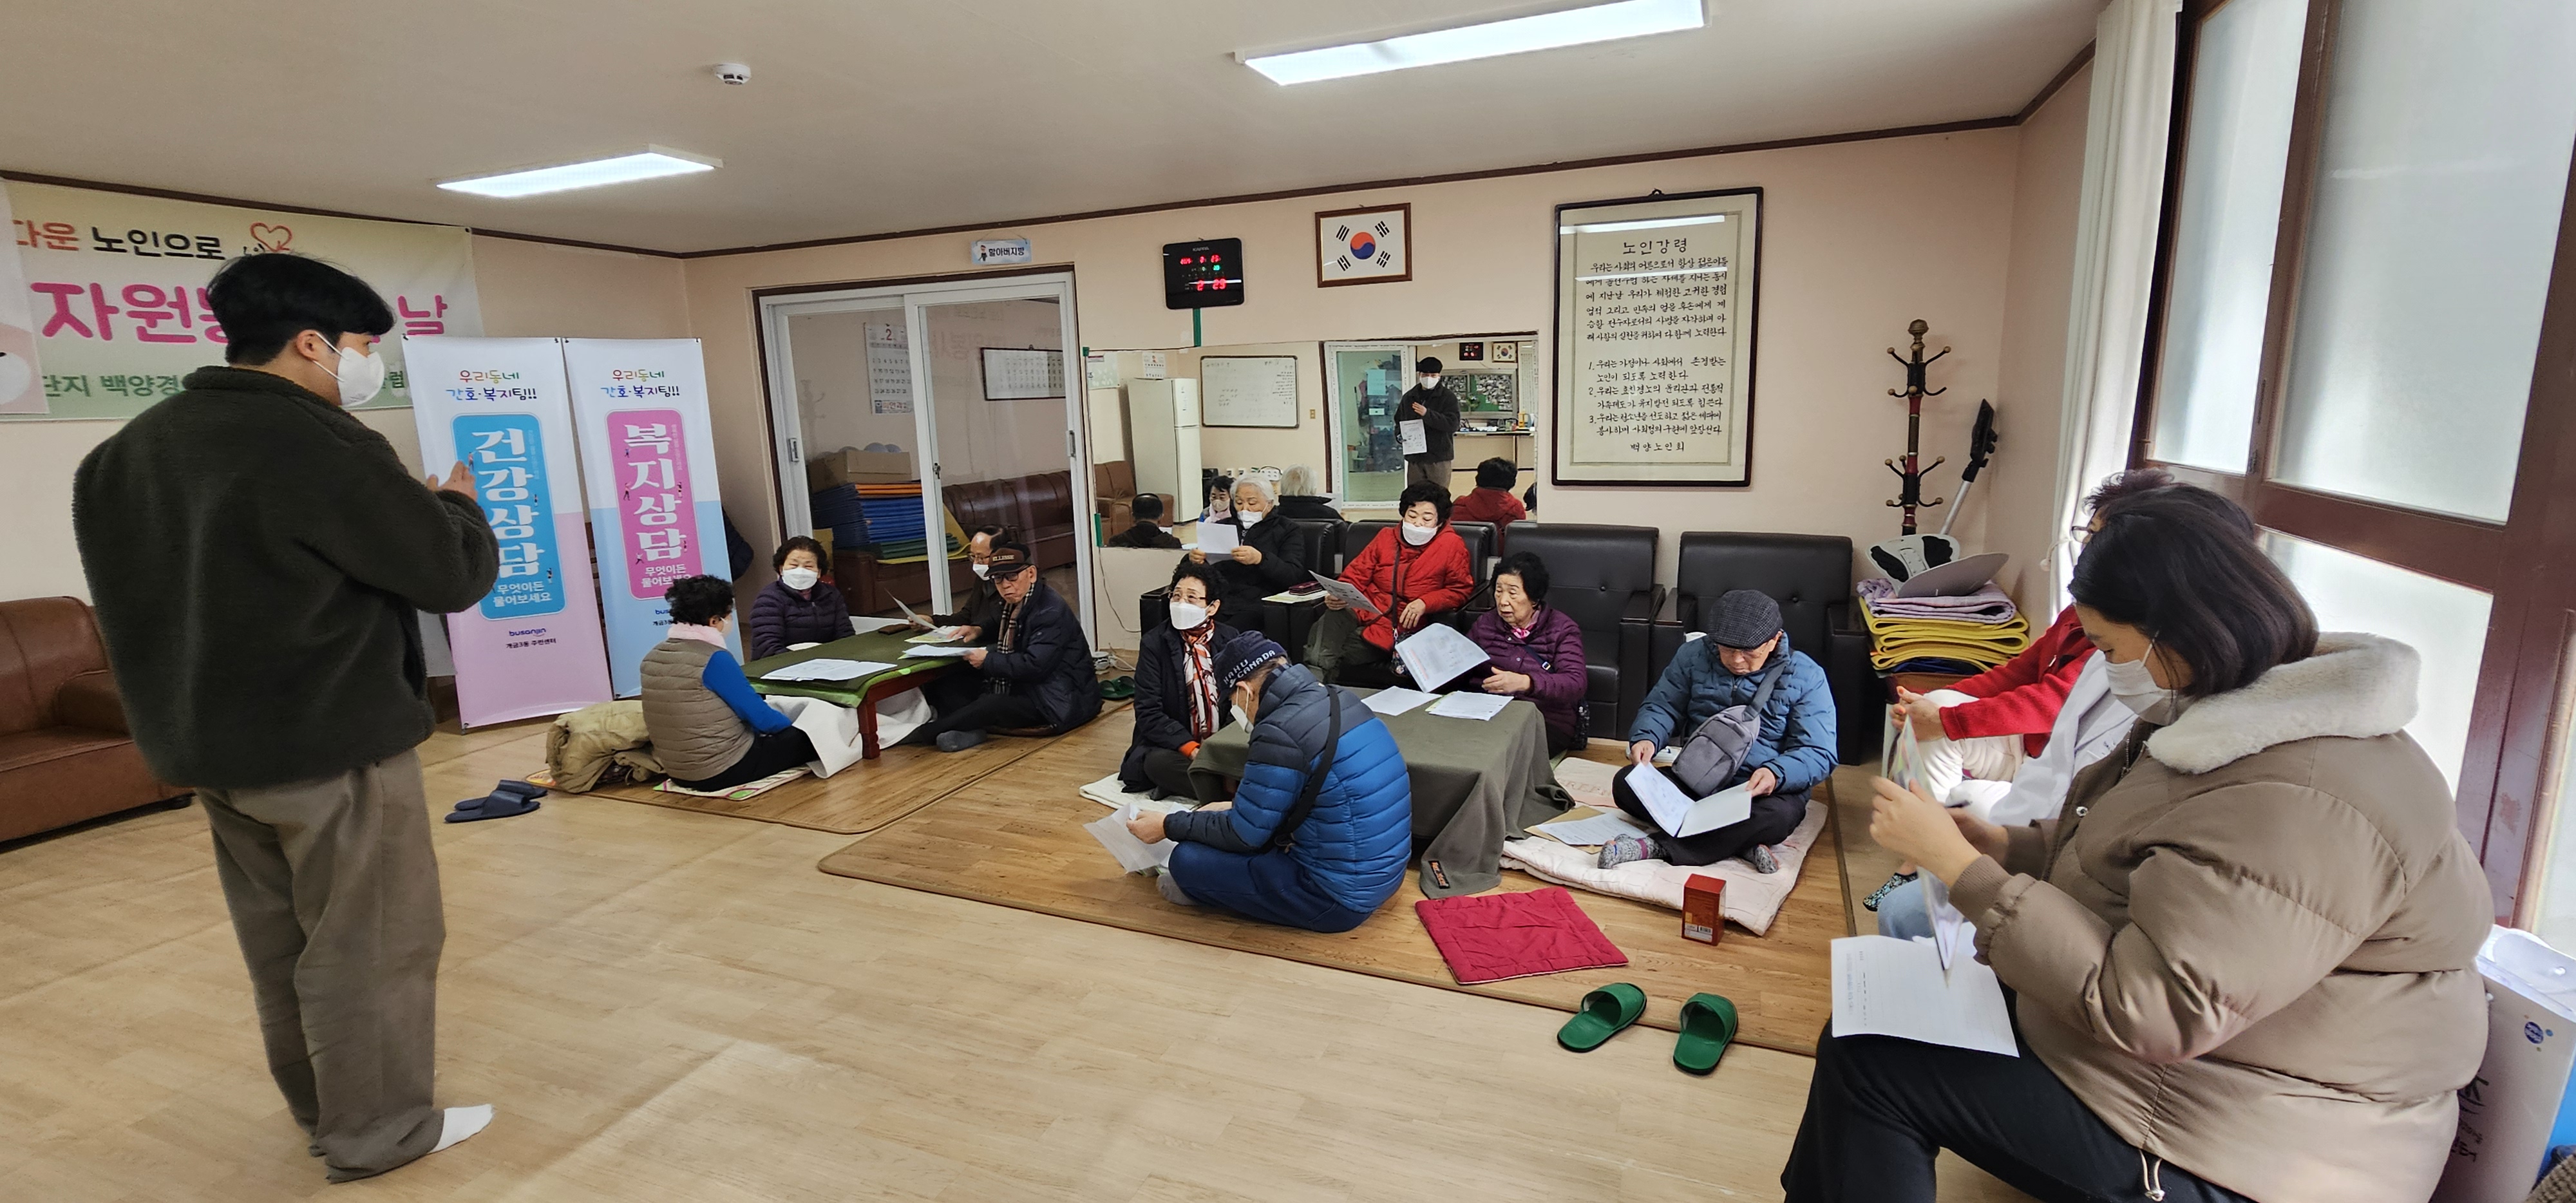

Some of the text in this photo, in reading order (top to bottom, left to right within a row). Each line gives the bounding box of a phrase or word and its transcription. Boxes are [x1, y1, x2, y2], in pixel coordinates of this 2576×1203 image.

[91, 226, 226, 260] 노인으로
[1622, 238, 1687, 255] 노인강령
[988, 247, 1025, 257] 할아버지방
[1614, 261, 1636, 271] 사회의
[1638, 259, 1674, 270] 어른으로서
[1678, 258, 1695, 269] 항상
[1586, 292, 1595, 302] 에
[1627, 289, 1653, 299] 우리가
[1682, 285, 1710, 298] 고귀한
[1711, 283, 1727, 296] 경험
[397, 294, 448, 336] 날
[1586, 306, 1602, 316] 업적
[1605, 305, 1630, 315] 그리고
[1716, 313, 1726, 322] 아
[1694, 327, 1727, 337] 노력한다
[1596, 359, 1618, 370] 우리는
[1619, 358, 1650, 368] 가정이나
[1652, 357, 1683, 367] 사회에서
[460, 370, 519, 384] 우리동네
[612, 369, 665, 382] 우리동네
[1596, 372, 1618, 383] 노인이
[1622, 372, 1646, 381] 되도록
[99, 375, 184, 397] 백양경
[1596, 386, 1619, 395] 우리는
[1665, 383, 1699, 394] 윤리관과
[1701, 383, 1724, 394] 전통적
[1672, 397, 1695, 408] 되도록
[1596, 413, 1619, 422] 우리는
[1631, 424, 1662, 435] 사회정의
[1690, 424, 1723, 436] 앞장선다
[1631, 440, 1685, 452] 백양노인회
[623, 422, 687, 562] 복지상담
[471, 428, 545, 578] 건강상담
[645, 564, 687, 576] 무엇이든
[497, 581, 545, 594] 무엇이든
[493, 592, 553, 607] 물어보세요
[509, 628, 547, 637] busanjin
[1237, 650, 1276, 678] CANADA
